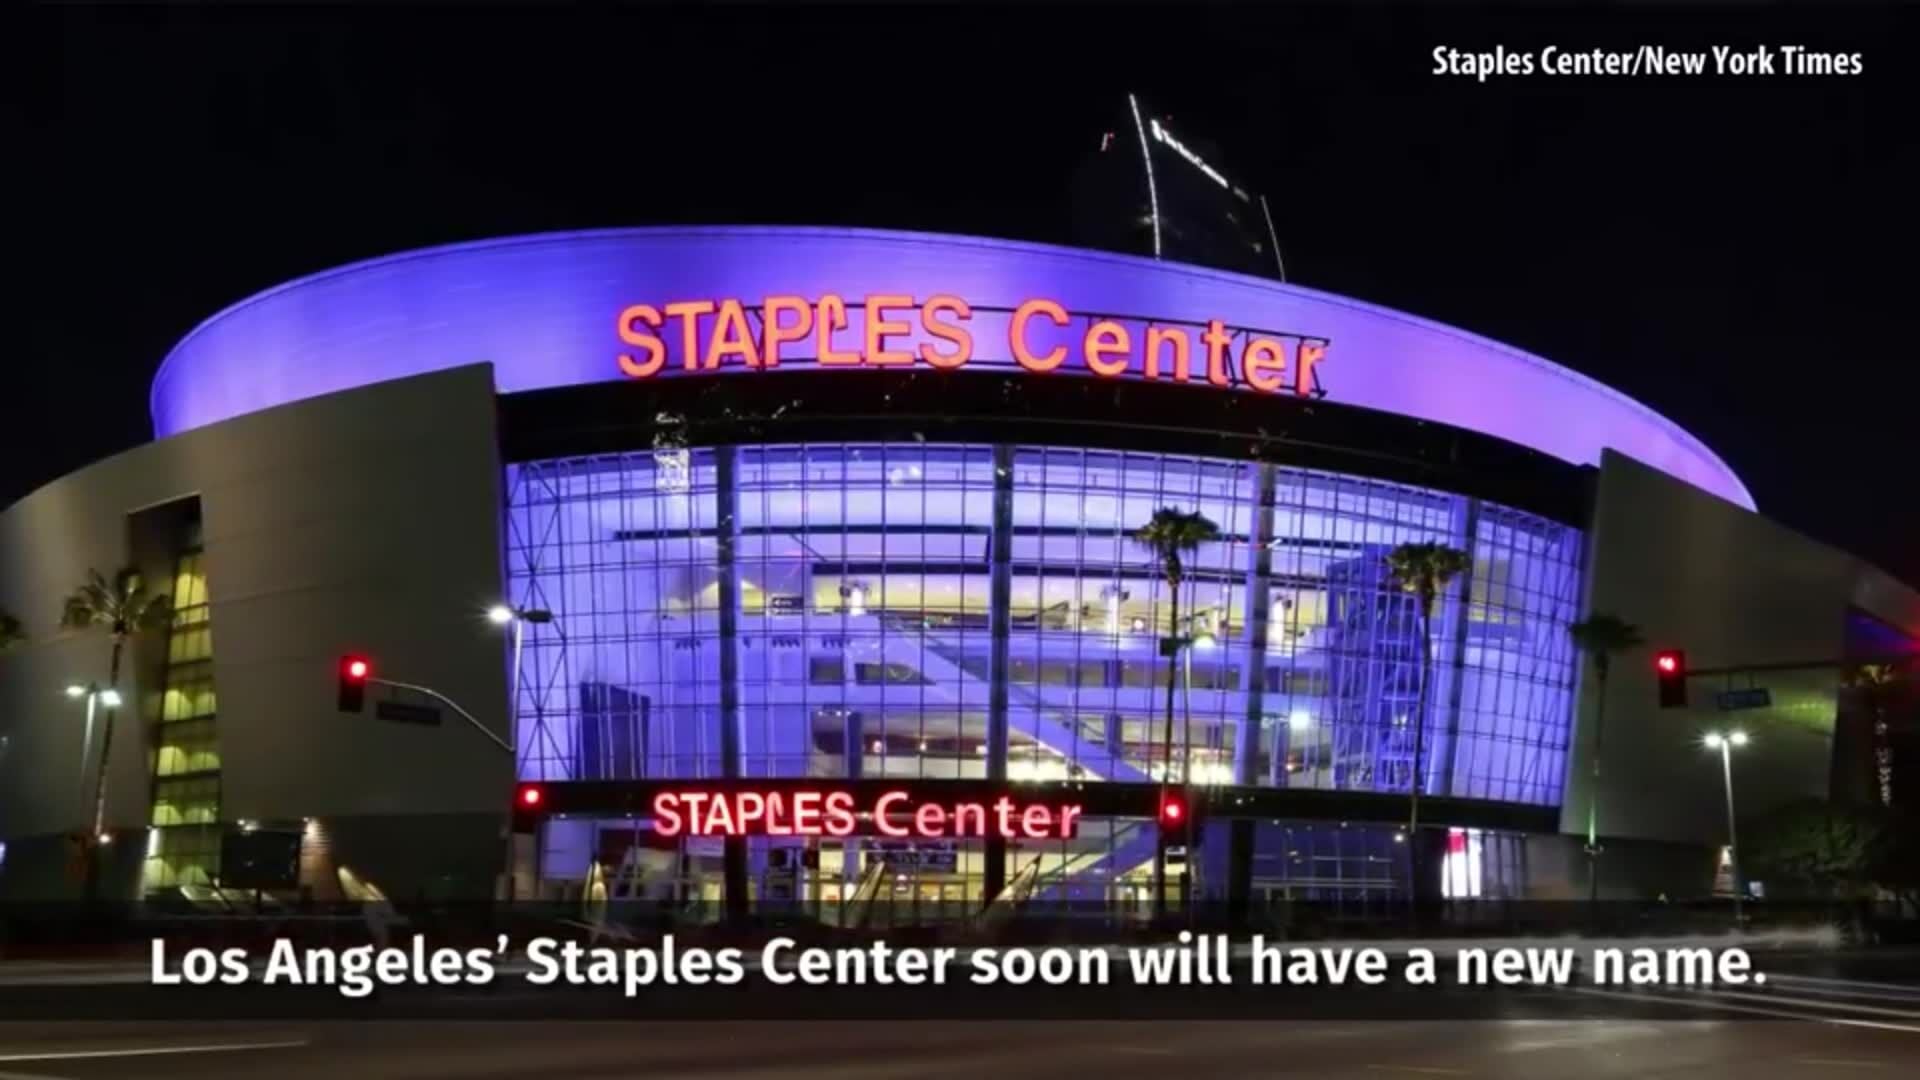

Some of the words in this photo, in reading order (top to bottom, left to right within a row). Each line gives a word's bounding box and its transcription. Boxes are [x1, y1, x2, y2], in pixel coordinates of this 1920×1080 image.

[616, 294, 975, 378] STAPLES
[1008, 298, 1325, 397] Center
[652, 791, 856, 836] STAPLES
[874, 790, 1083, 838] Center
